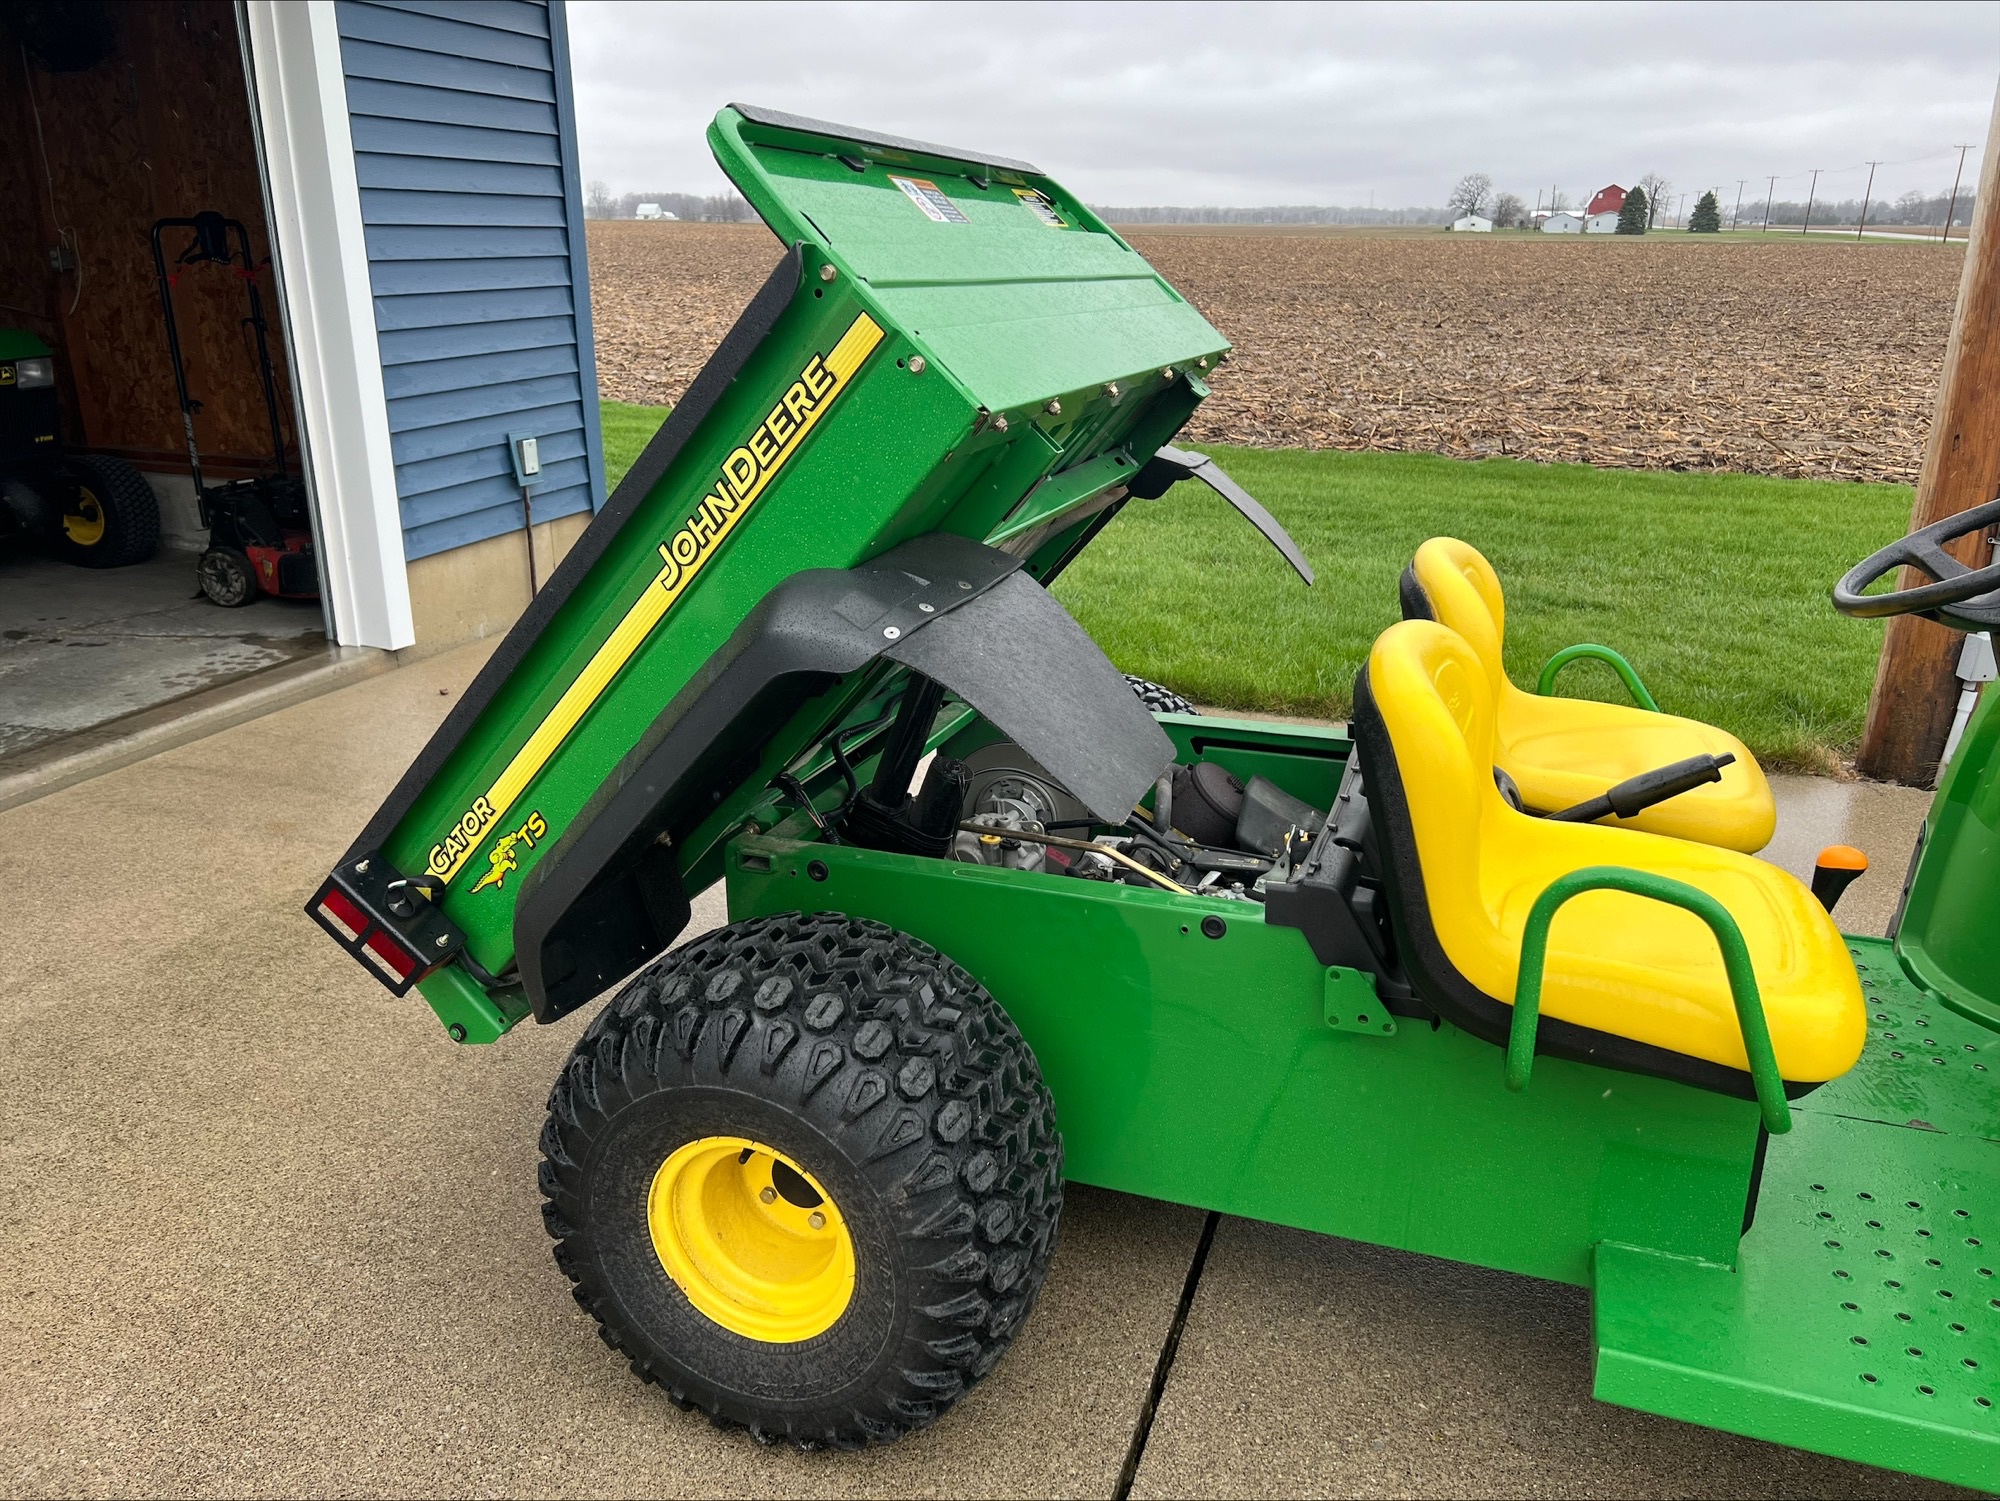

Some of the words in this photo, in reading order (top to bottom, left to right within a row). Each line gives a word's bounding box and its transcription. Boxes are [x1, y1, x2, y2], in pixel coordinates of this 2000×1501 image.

[657, 477, 740, 591] JOHN
[720, 351, 838, 499] DEERE
[428, 795, 496, 876] GATOR
[516, 810, 548, 850] TS
